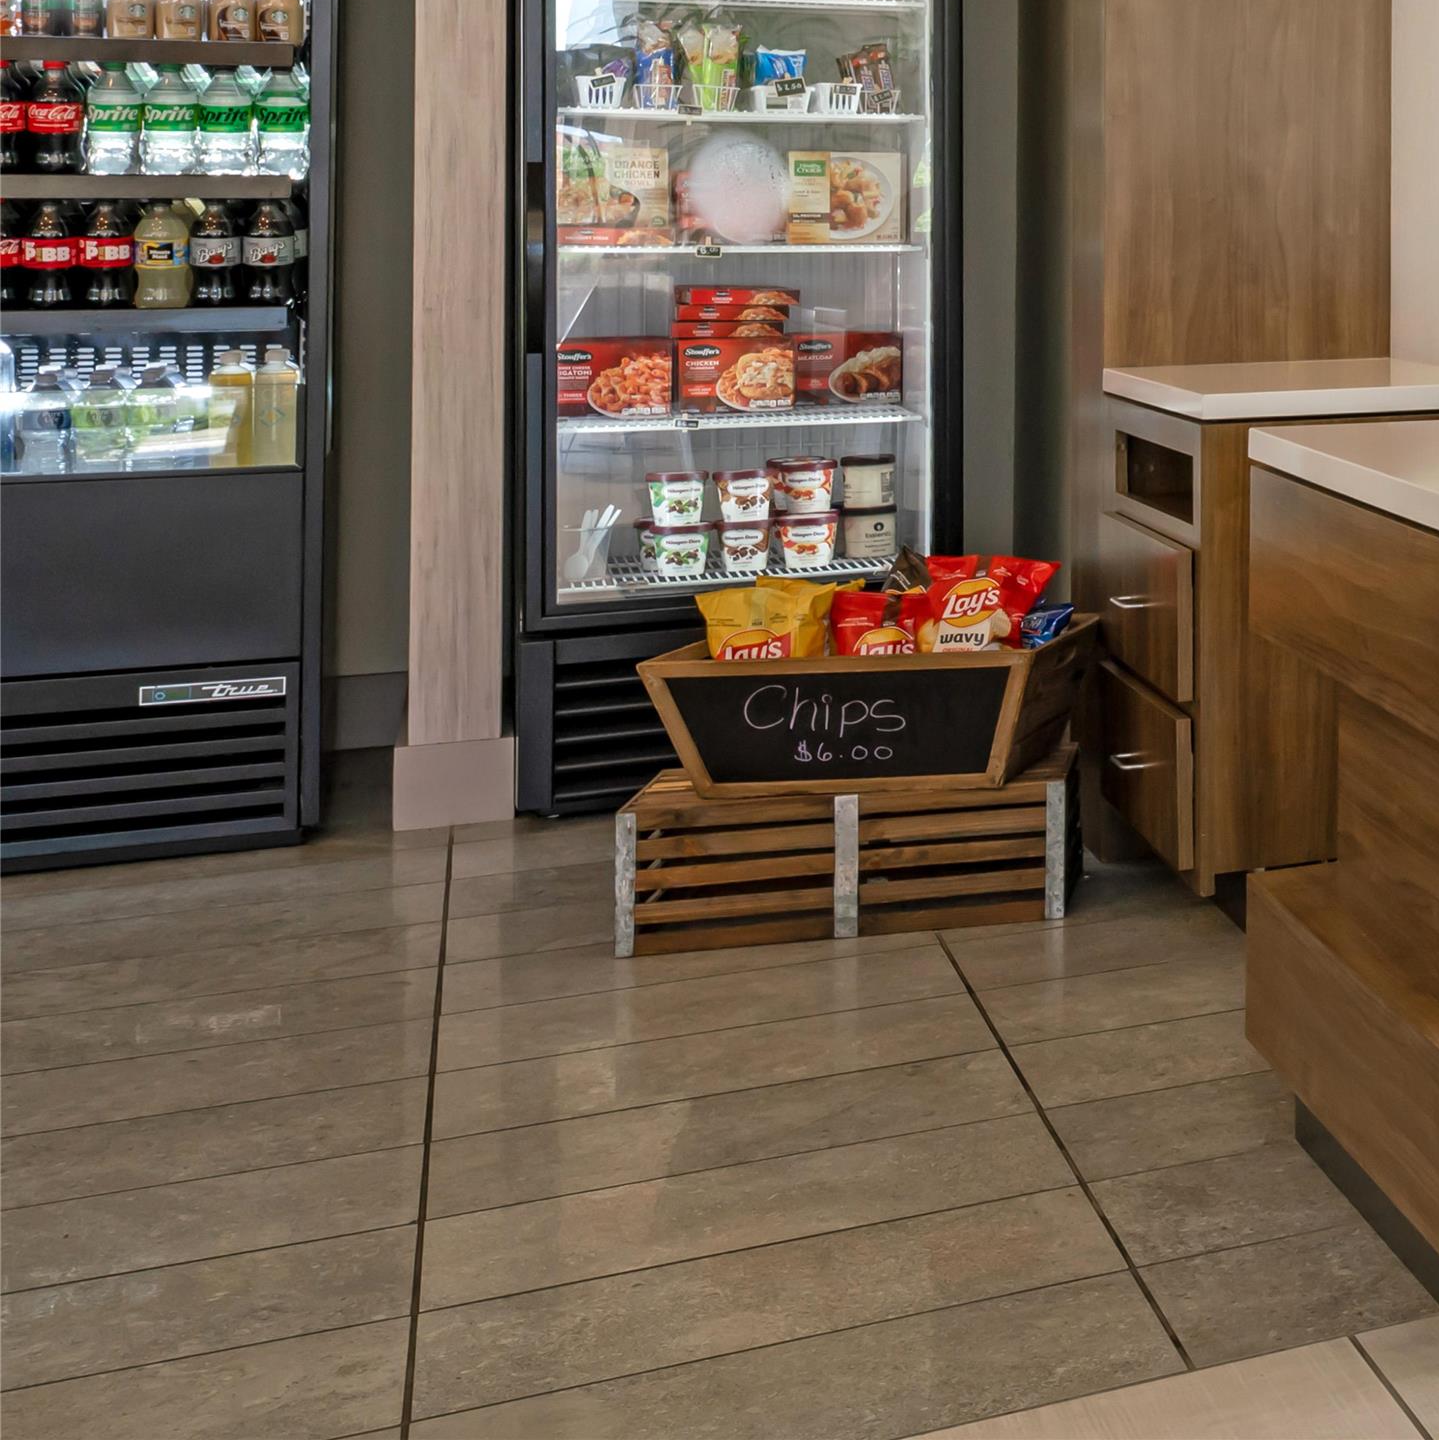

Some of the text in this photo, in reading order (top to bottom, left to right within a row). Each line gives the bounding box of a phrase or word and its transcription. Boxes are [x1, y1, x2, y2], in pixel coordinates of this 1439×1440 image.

[87, 105, 138, 123] Sprite
[144, 105, 194, 123] Sprite
[199, 107, 249, 124] Sprite
[257, 107, 307, 124] Sprite
[614, 160, 660, 170] ORANGE
[614, 170, 660, 179] CHICKEN
[198, 242, 233, 262] Barq's
[251, 241, 285, 262] Barq's
[684, 347, 720, 357] Stouffer's
[942, 586, 1000, 620] Lay's
[940, 632, 985, 647] wavy
[743, 684, 906, 739] Chips
[793, 740, 894, 763] $6.00
